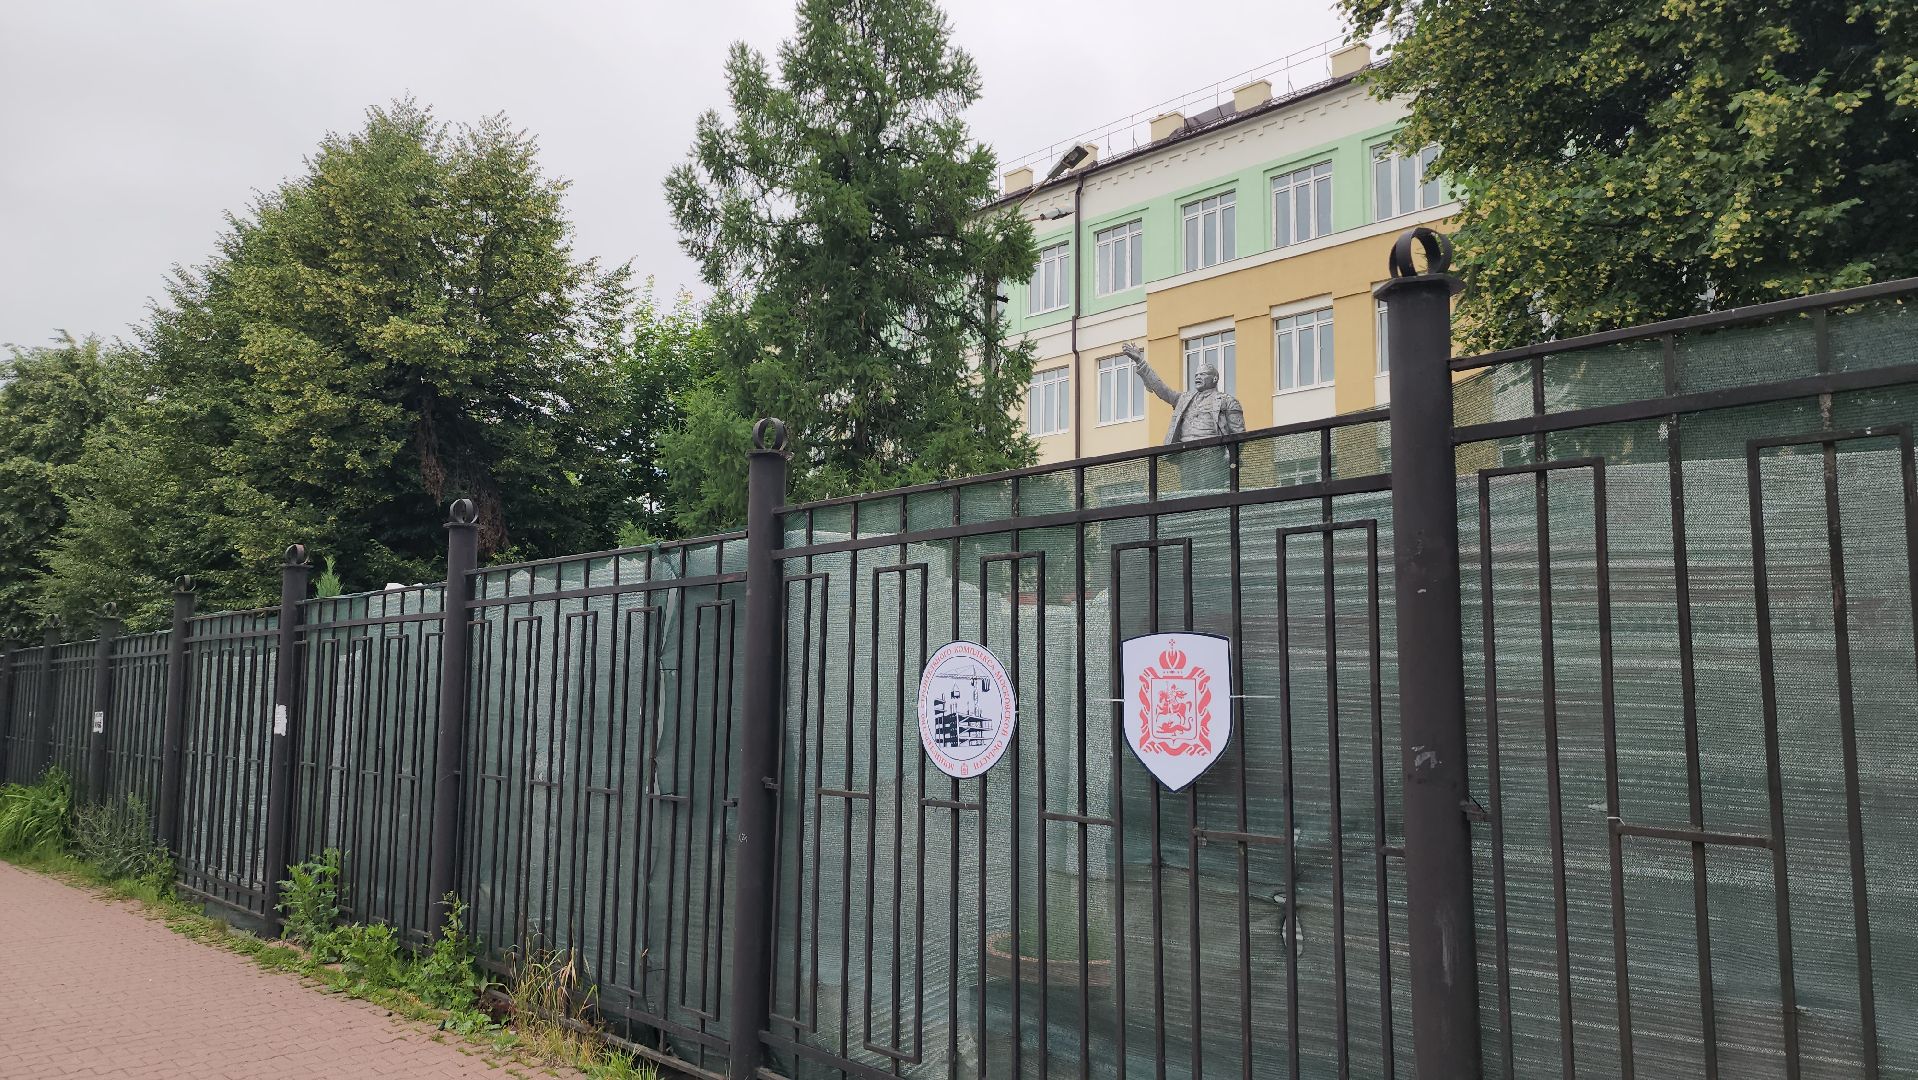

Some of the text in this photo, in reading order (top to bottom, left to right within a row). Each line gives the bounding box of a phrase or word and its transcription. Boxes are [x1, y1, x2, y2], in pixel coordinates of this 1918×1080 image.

[954, 645, 995, 671] КОМПЛЕКСА
[995, 671, 1011, 736] МОСКОВСКОЙ
[973, 740, 1003, 769] ОБЛАСТИ
